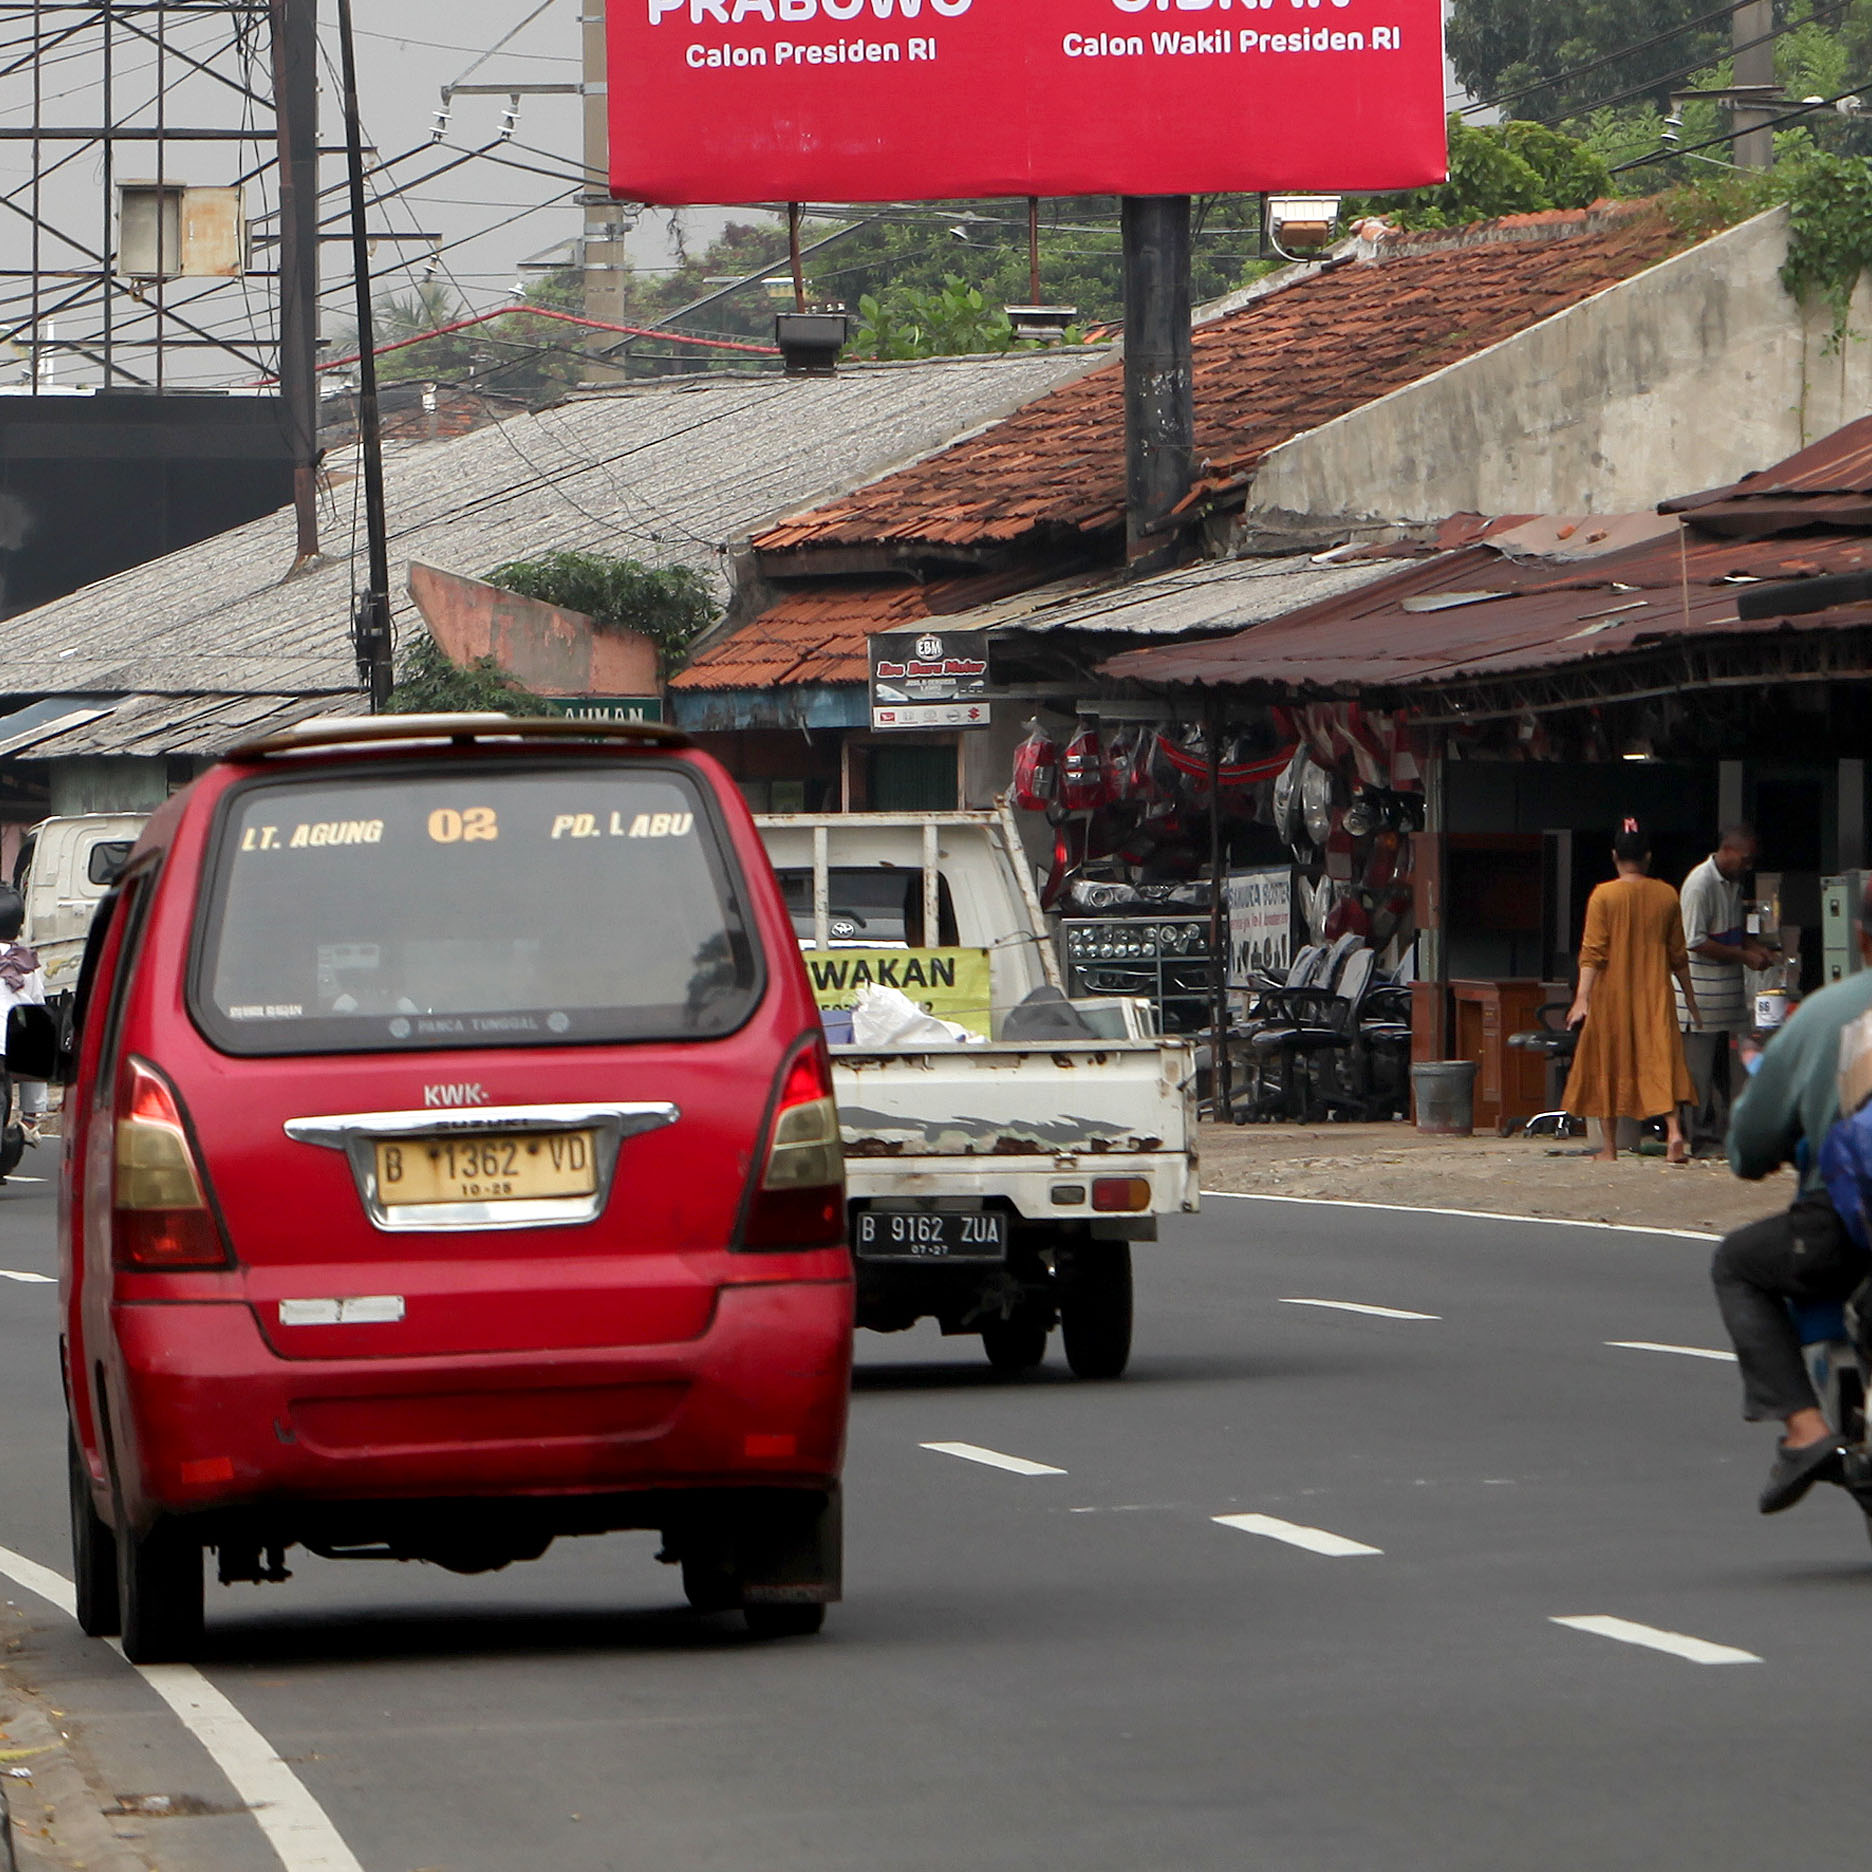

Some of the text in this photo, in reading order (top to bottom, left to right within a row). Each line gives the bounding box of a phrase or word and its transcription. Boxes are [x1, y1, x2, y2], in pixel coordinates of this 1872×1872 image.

[685, 37, 937, 69] Calon Presiden RI
[1062, 25, 1401, 59] Calon Wakil Presiden RI
[241, 828, 281, 850] LT.
[289, 820, 384, 848] AGUNG
[428, 807, 498, 843] 02
[551, 814, 601, 839] PD.
[385, 1135, 586, 1183] B 1362 VD
[862, 1216, 999, 1242] B 9162 ZUA
